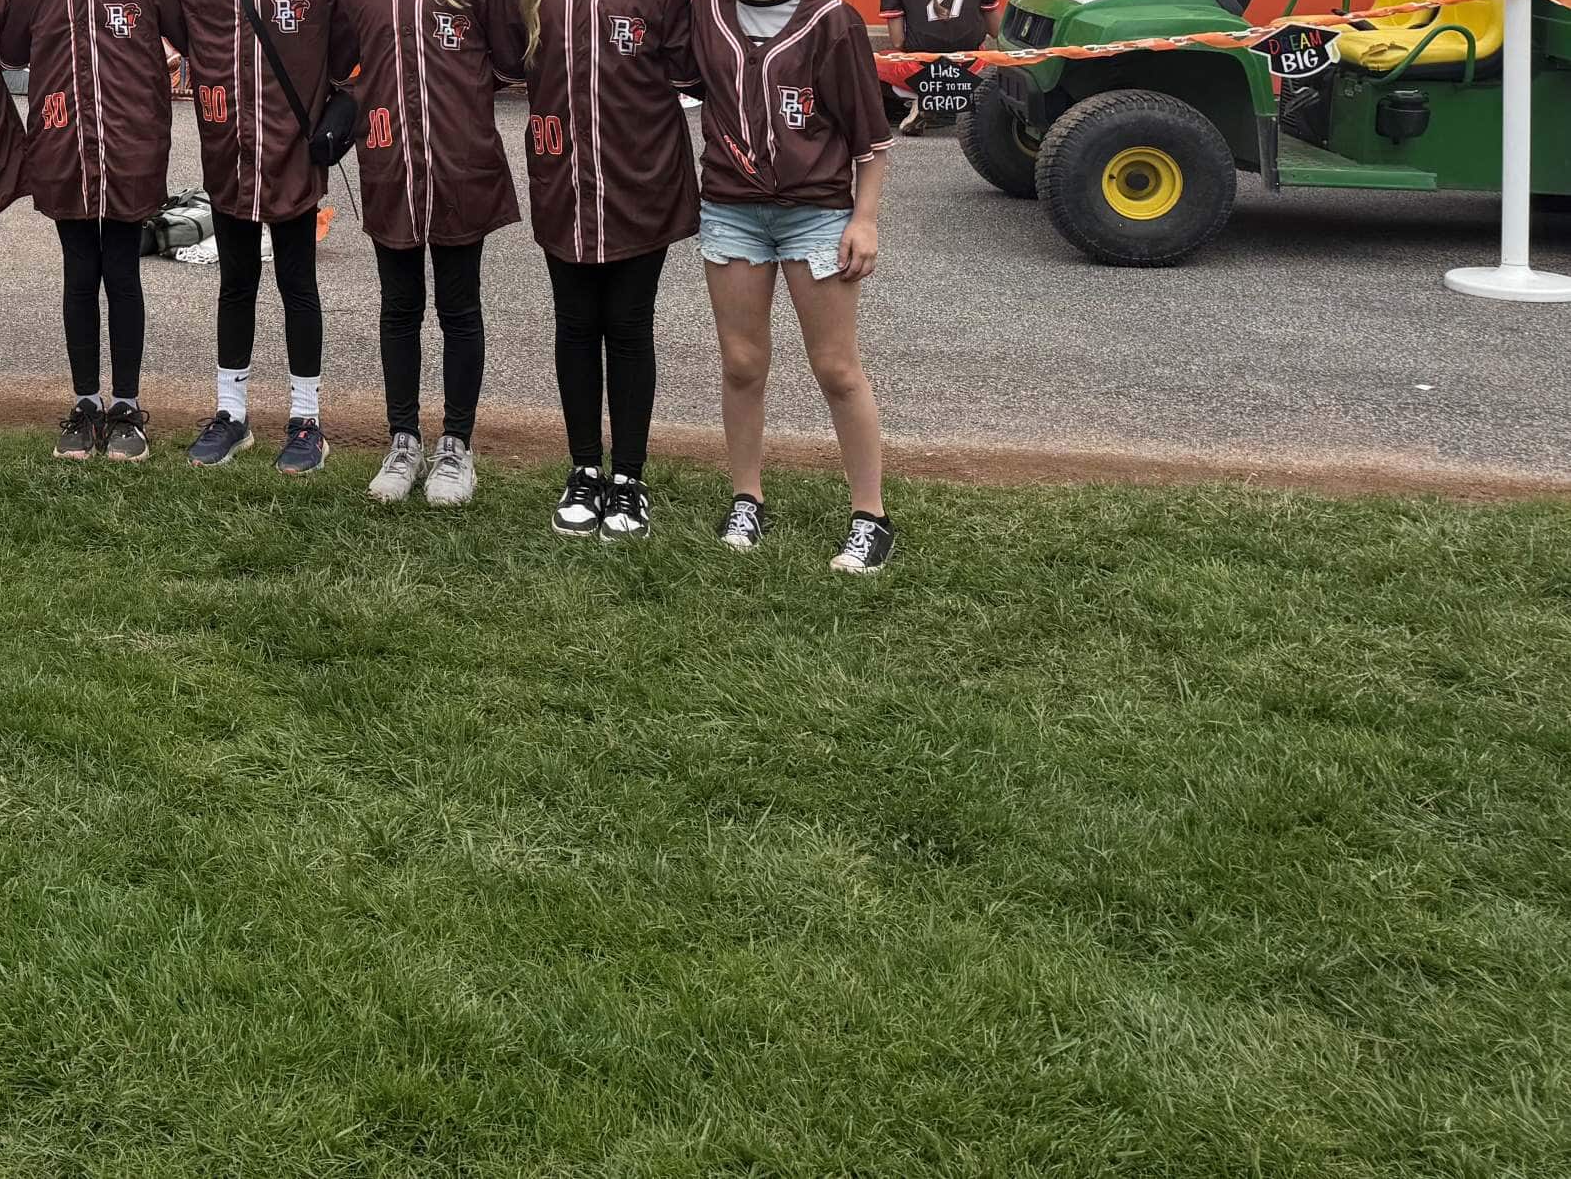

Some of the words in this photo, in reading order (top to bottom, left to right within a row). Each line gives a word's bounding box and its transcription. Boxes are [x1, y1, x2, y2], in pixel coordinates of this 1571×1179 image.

[1269, 30, 1322, 54] DREAM
[1280, 48, 1319, 73] BIG
[930, 64, 960, 79] Hats
[919, 81, 942, 93] OFF
[946, 82, 955, 91] TO
[957, 82, 973, 91] THE
[922, 95, 968, 111] GRAD
[531, 115, 562, 155] 90
